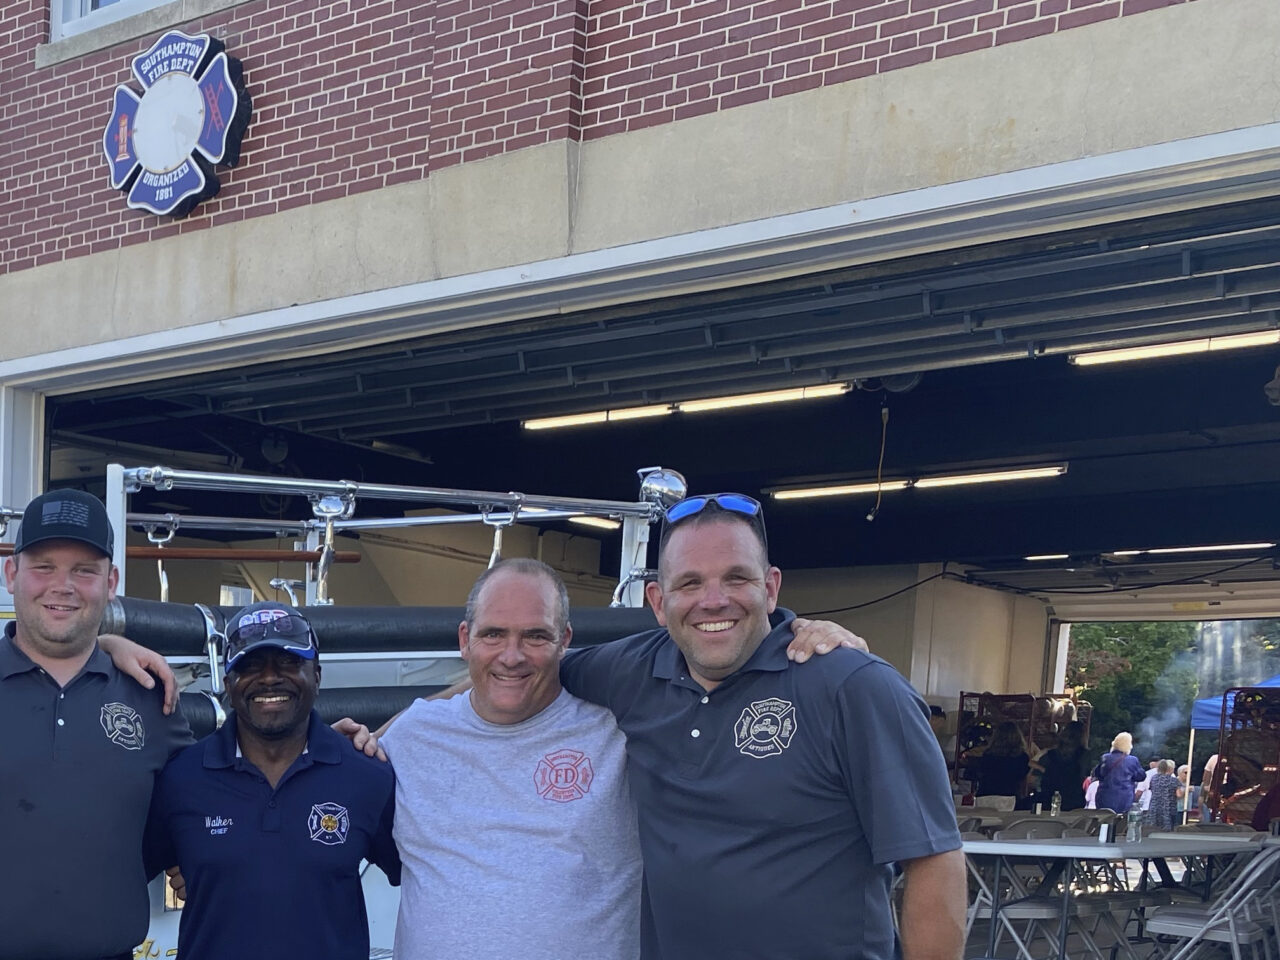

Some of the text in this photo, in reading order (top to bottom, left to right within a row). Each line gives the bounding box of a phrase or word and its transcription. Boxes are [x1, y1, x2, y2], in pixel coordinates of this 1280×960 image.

[140, 42, 202, 74] SOUTHAMPTON
[148, 57, 194, 84] FIRE DEPT
[142, 162, 190, 187] ORGANIZED
[155, 187, 173, 201] 1881
[554, 768, 576, 784] FD
[205, 815, 234, 828] Walker
